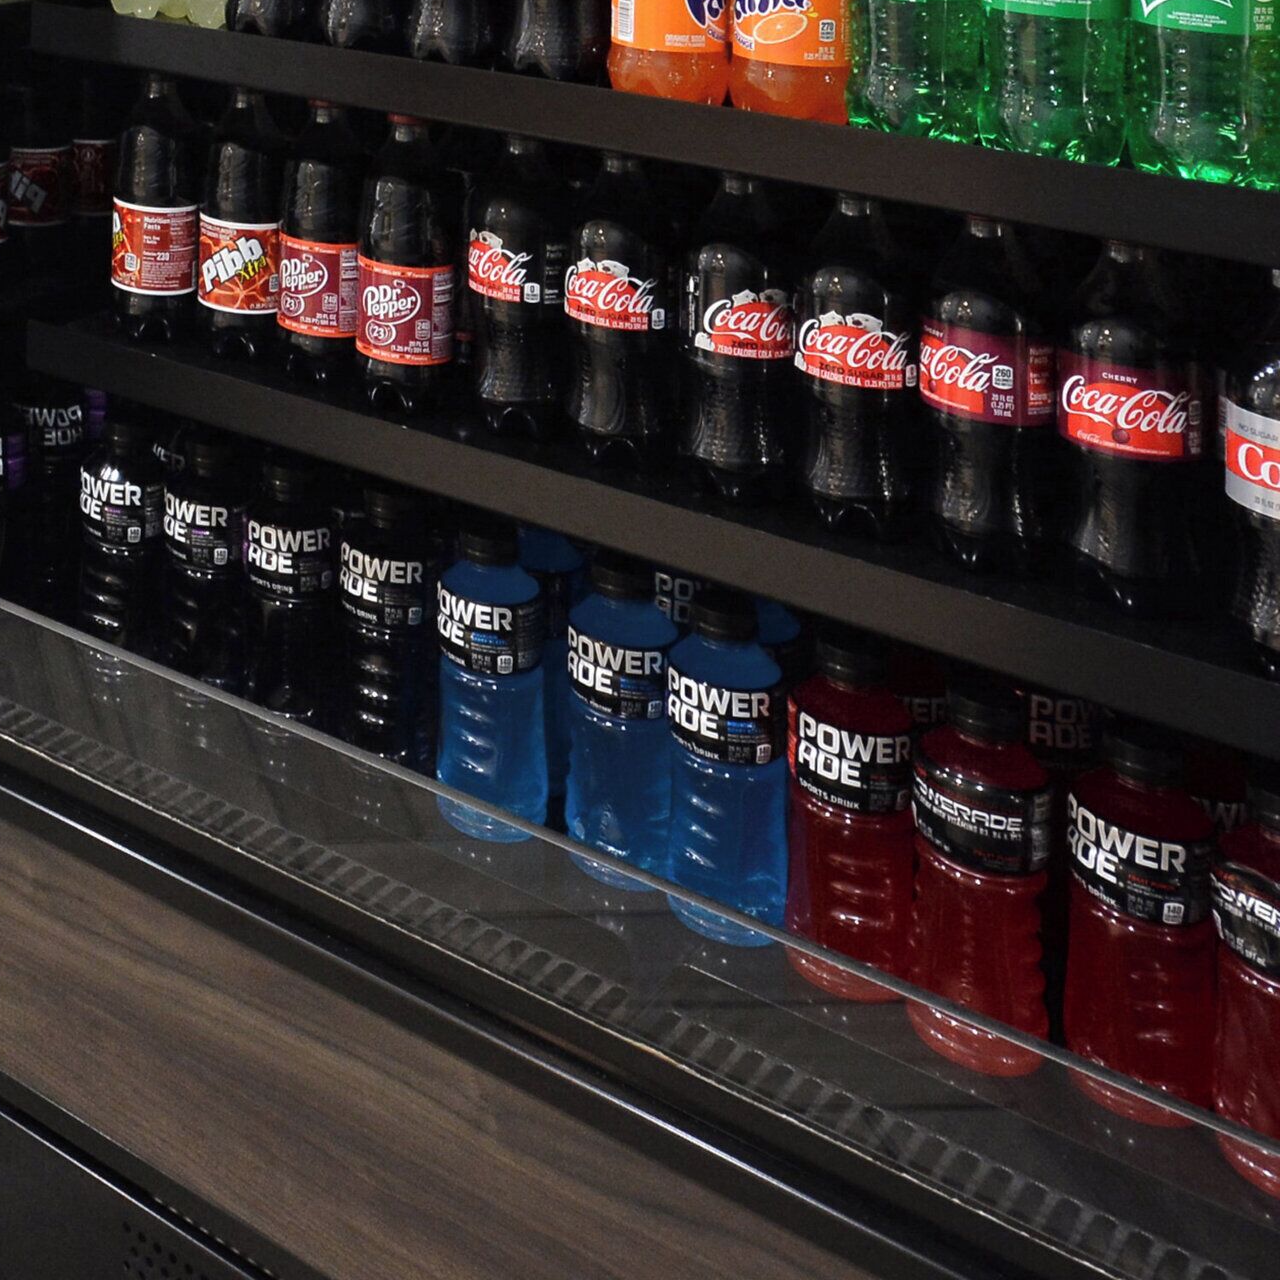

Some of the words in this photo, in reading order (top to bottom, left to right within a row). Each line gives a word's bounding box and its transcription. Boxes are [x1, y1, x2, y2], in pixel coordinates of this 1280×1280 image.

[735, 30, 755, 50] RANGE
[202, 236, 263, 293] Pibb
[280, 259, 324, 292] Pepper
[291, 258, 310, 276] Dr
[363, 286, 416, 320] Pepper
[381, 285, 402, 303] Dr
[565, 265, 659, 314] Coca-Cola
[372, 325, 384, 338] 23
[703, 299, 792, 342] Coca-Co
[799, 318, 911, 372] Coca-Cola
[920, 344, 999, 393] a-Cola
[995, 367, 1012, 379] 260
[1102, 372, 1138, 384] CHERRY
[1062, 374, 1191, 434] Coca-Cola
[1238, 443, 1280, 489] Co
[248, 519, 331, 553] POWER
[340, 540, 423, 585] POWER
[567, 625, 662, 676] POWER
[668, 666, 771, 719] POWER
[799, 711, 911, 767] POWER
[830, 793, 861, 810] DRINK
